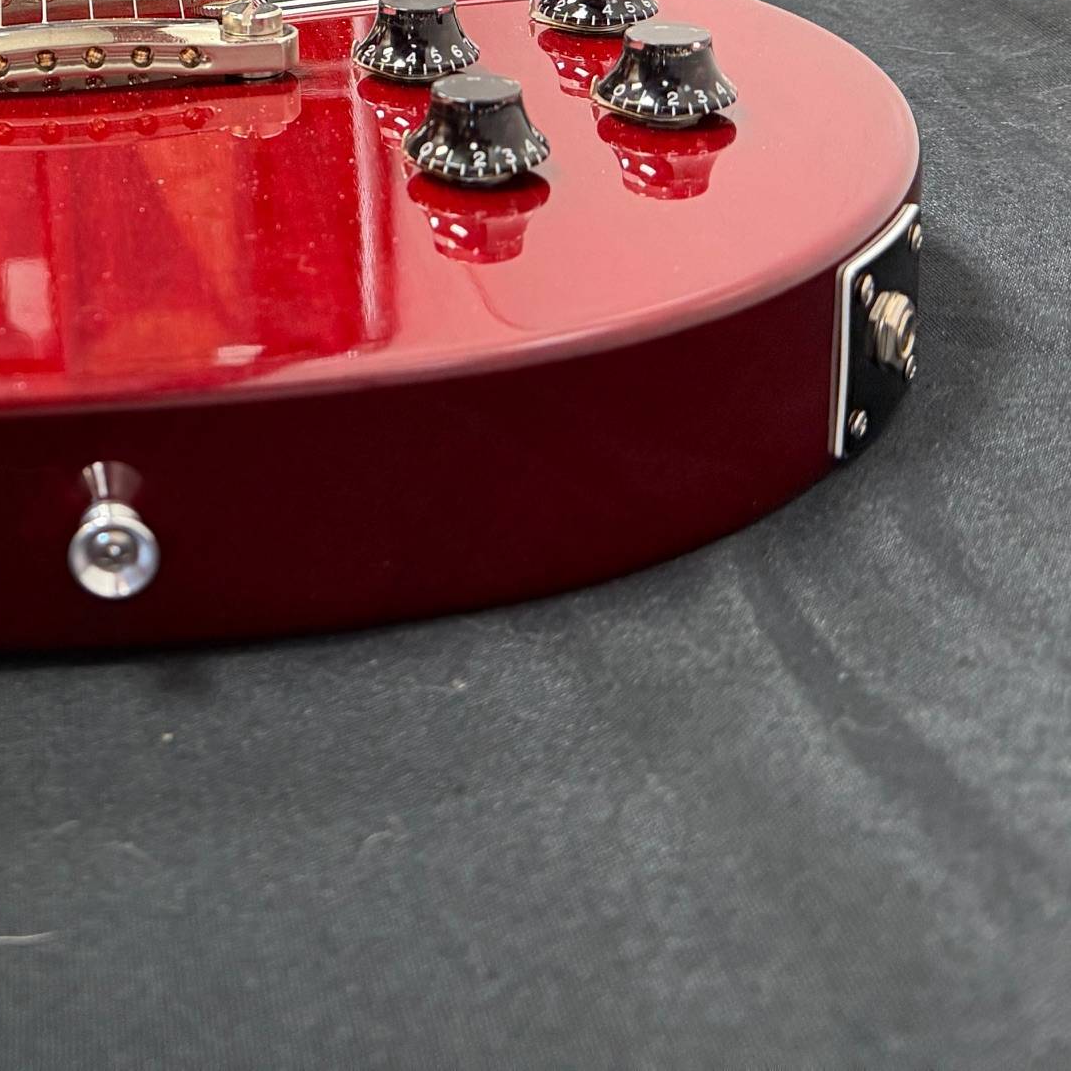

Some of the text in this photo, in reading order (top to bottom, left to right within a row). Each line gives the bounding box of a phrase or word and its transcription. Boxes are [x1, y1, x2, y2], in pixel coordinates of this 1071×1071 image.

[554, 0, 566, 12] 2
[602, 4, 614, 16] 4
[624, 1, 636, 14] 5
[364, 44, 376, 57] 2
[380, 46, 394, 63] 3
[406, 52, 417, 65] 4
[431, 47, 443, 64] 5
[451, 44, 464, 58] 6
[613, 83, 626, 96] 0
[667, 91, 680, 107] 2
[694, 89, 709, 104] 3
[715, 81, 728, 95] 4
[419, 141, 434, 157] 0
[472, 150, 487, 168] 2
[501, 147, 517, 165] 3
[524, 138, 538, 153] 4
